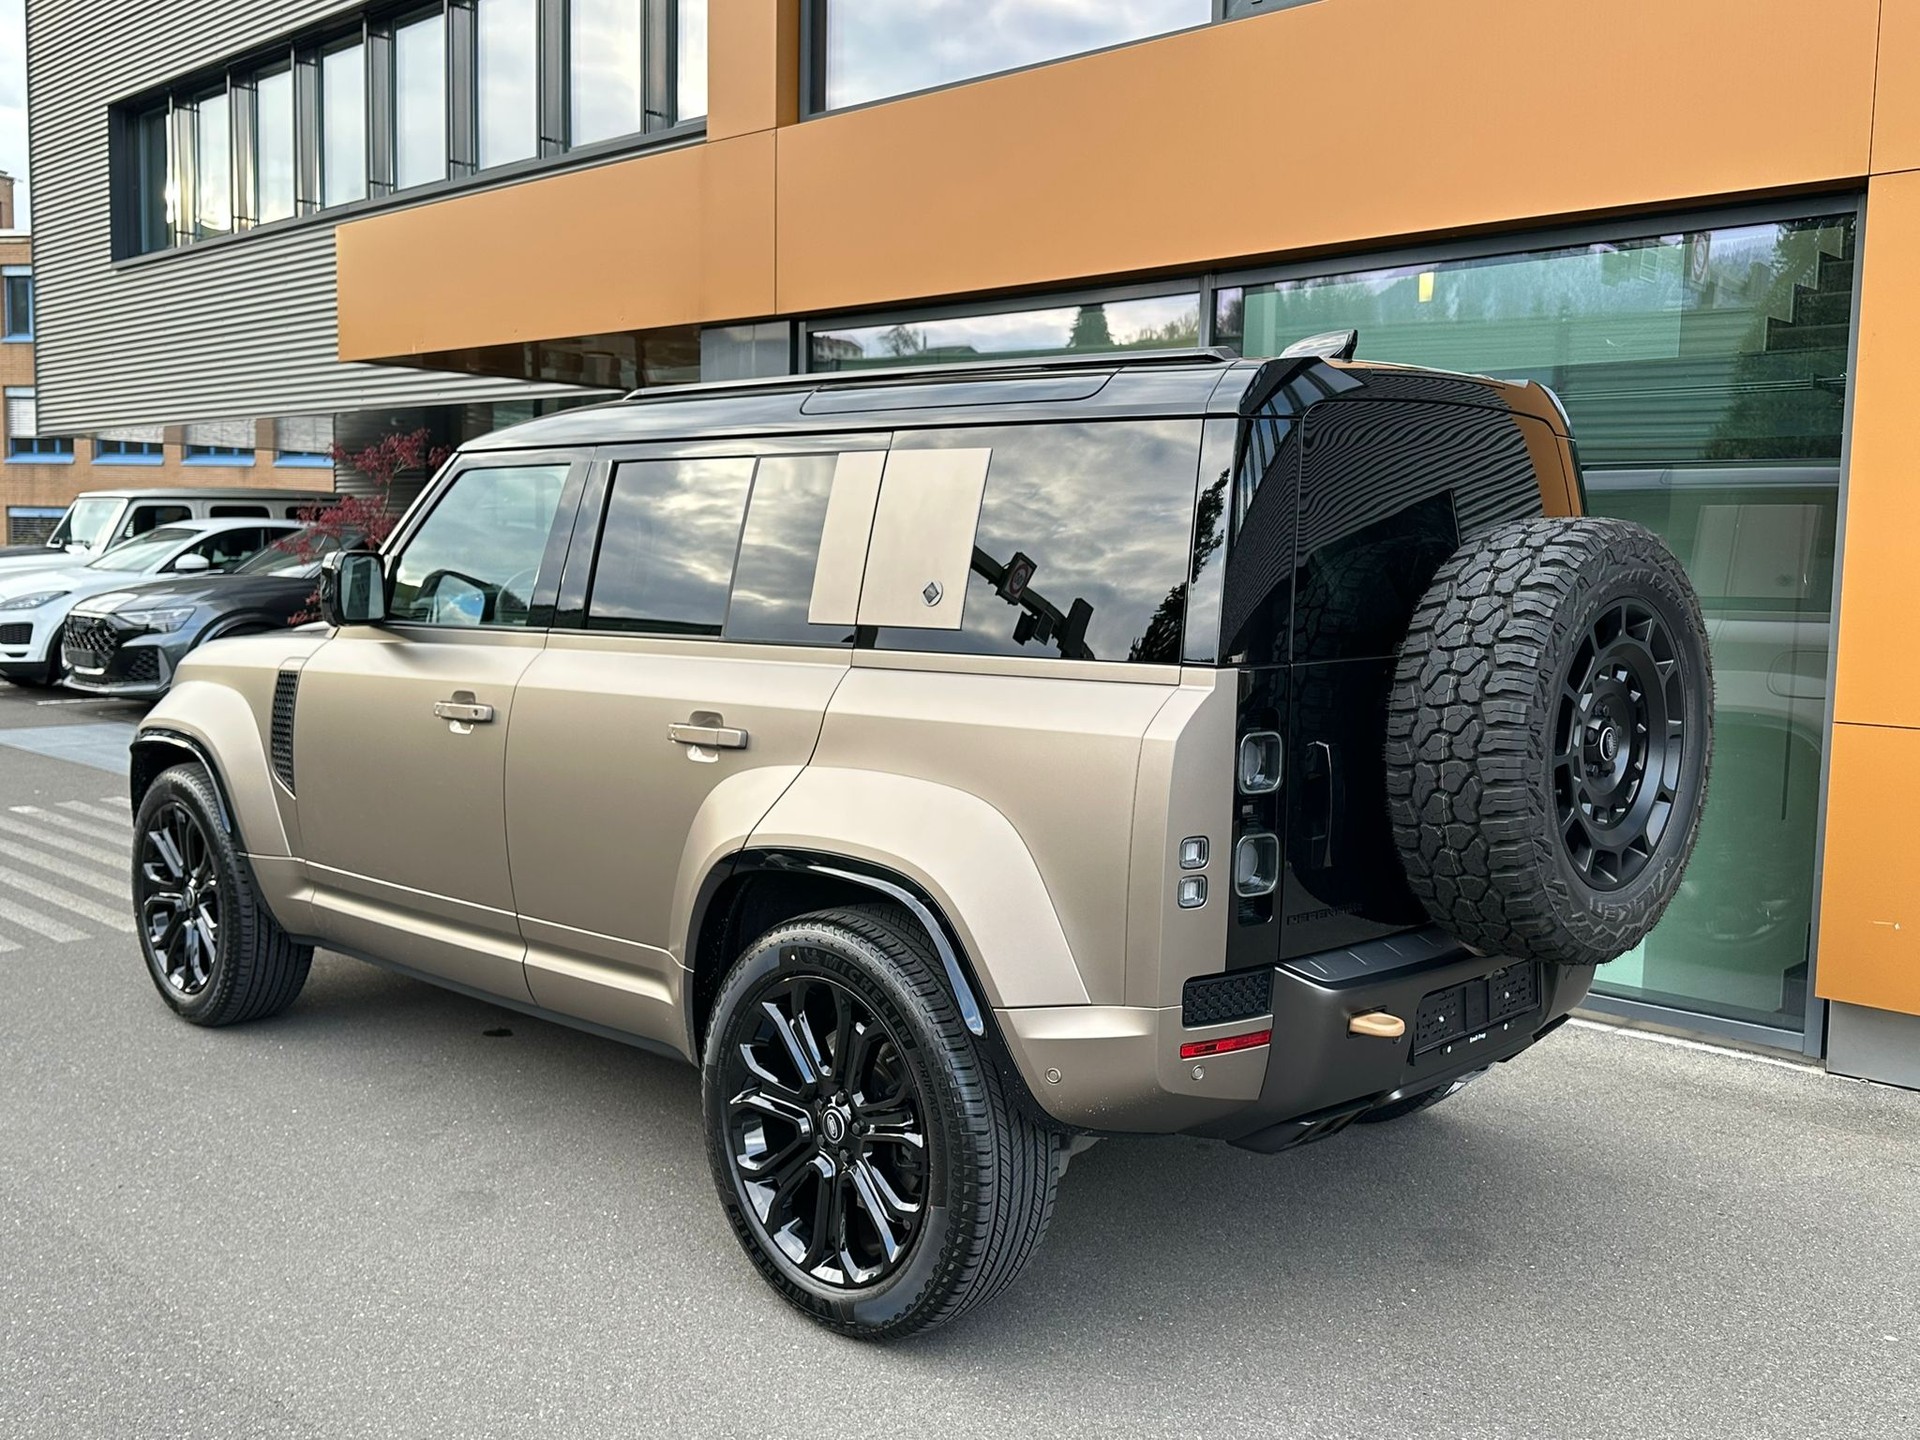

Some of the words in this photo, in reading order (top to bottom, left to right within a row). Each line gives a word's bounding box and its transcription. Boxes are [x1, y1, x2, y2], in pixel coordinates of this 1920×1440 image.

[823, 953, 912, 1044] MICHELIN
[916, 1060, 942, 1124] PRIMACY
[731, 1211, 809, 1305] MICHELIN
